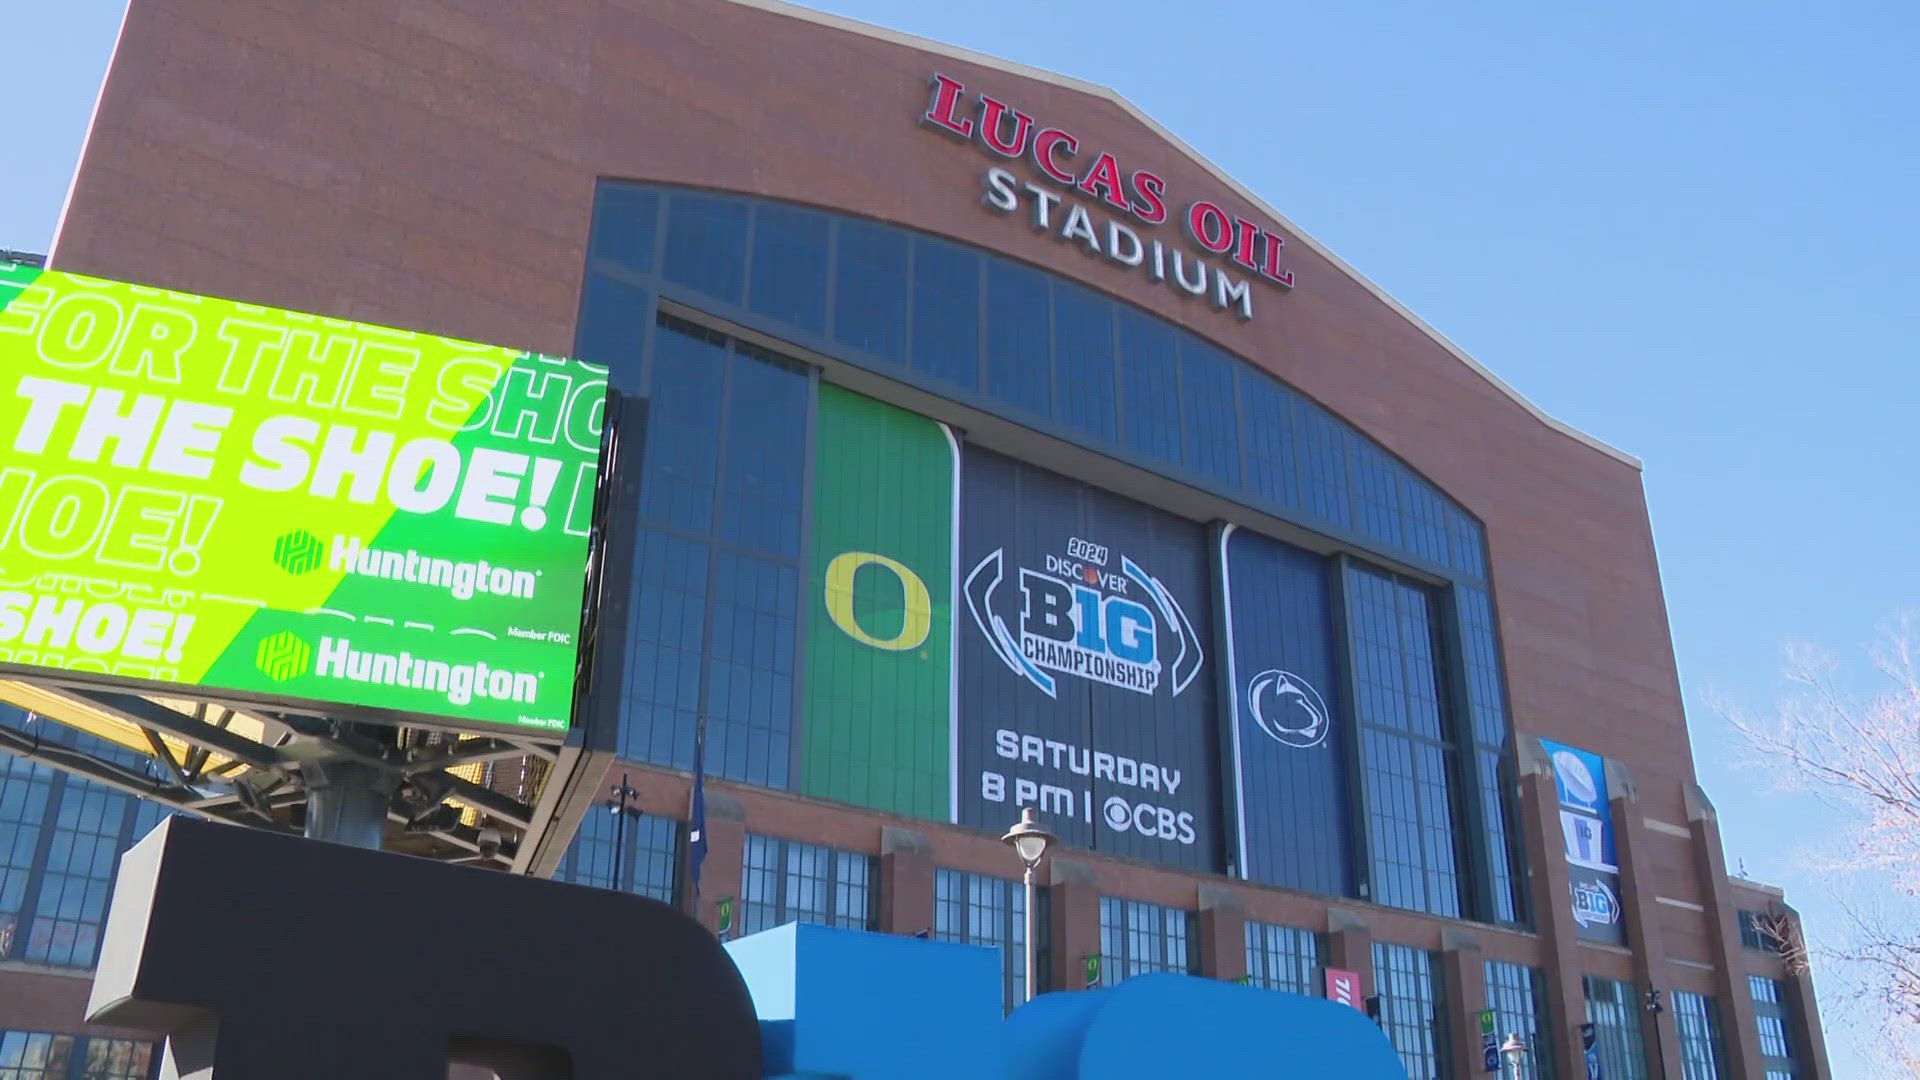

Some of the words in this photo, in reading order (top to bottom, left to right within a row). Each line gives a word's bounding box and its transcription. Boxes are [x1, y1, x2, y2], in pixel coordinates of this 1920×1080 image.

[921, 71, 1167, 225] LUCAS
[1184, 201, 1295, 289] OIL
[982, 167, 1254, 322] STADIUM
[217, 318, 420, 421] THE
[14, 375, 234, 480] THE
[239, 415, 563, 531] SHOE!
[329, 534, 536, 600] Huntington
[1046, 554, 1128, 594] DISCOVER
[1067, 537, 1109, 566] 2024
[0, 590, 197, 664] SHOE!
[508, 626, 547, 641] Member
[547, 631, 571, 645] FDIC
[315, 636, 539, 706] Huntington
[1023, 636, 1156, 691] CHAMPIONSHIP
[996, 729, 1181, 794] SATURDAY
[982, 771, 1005, 802] 8
[1133, 803, 1196, 844] CBS
